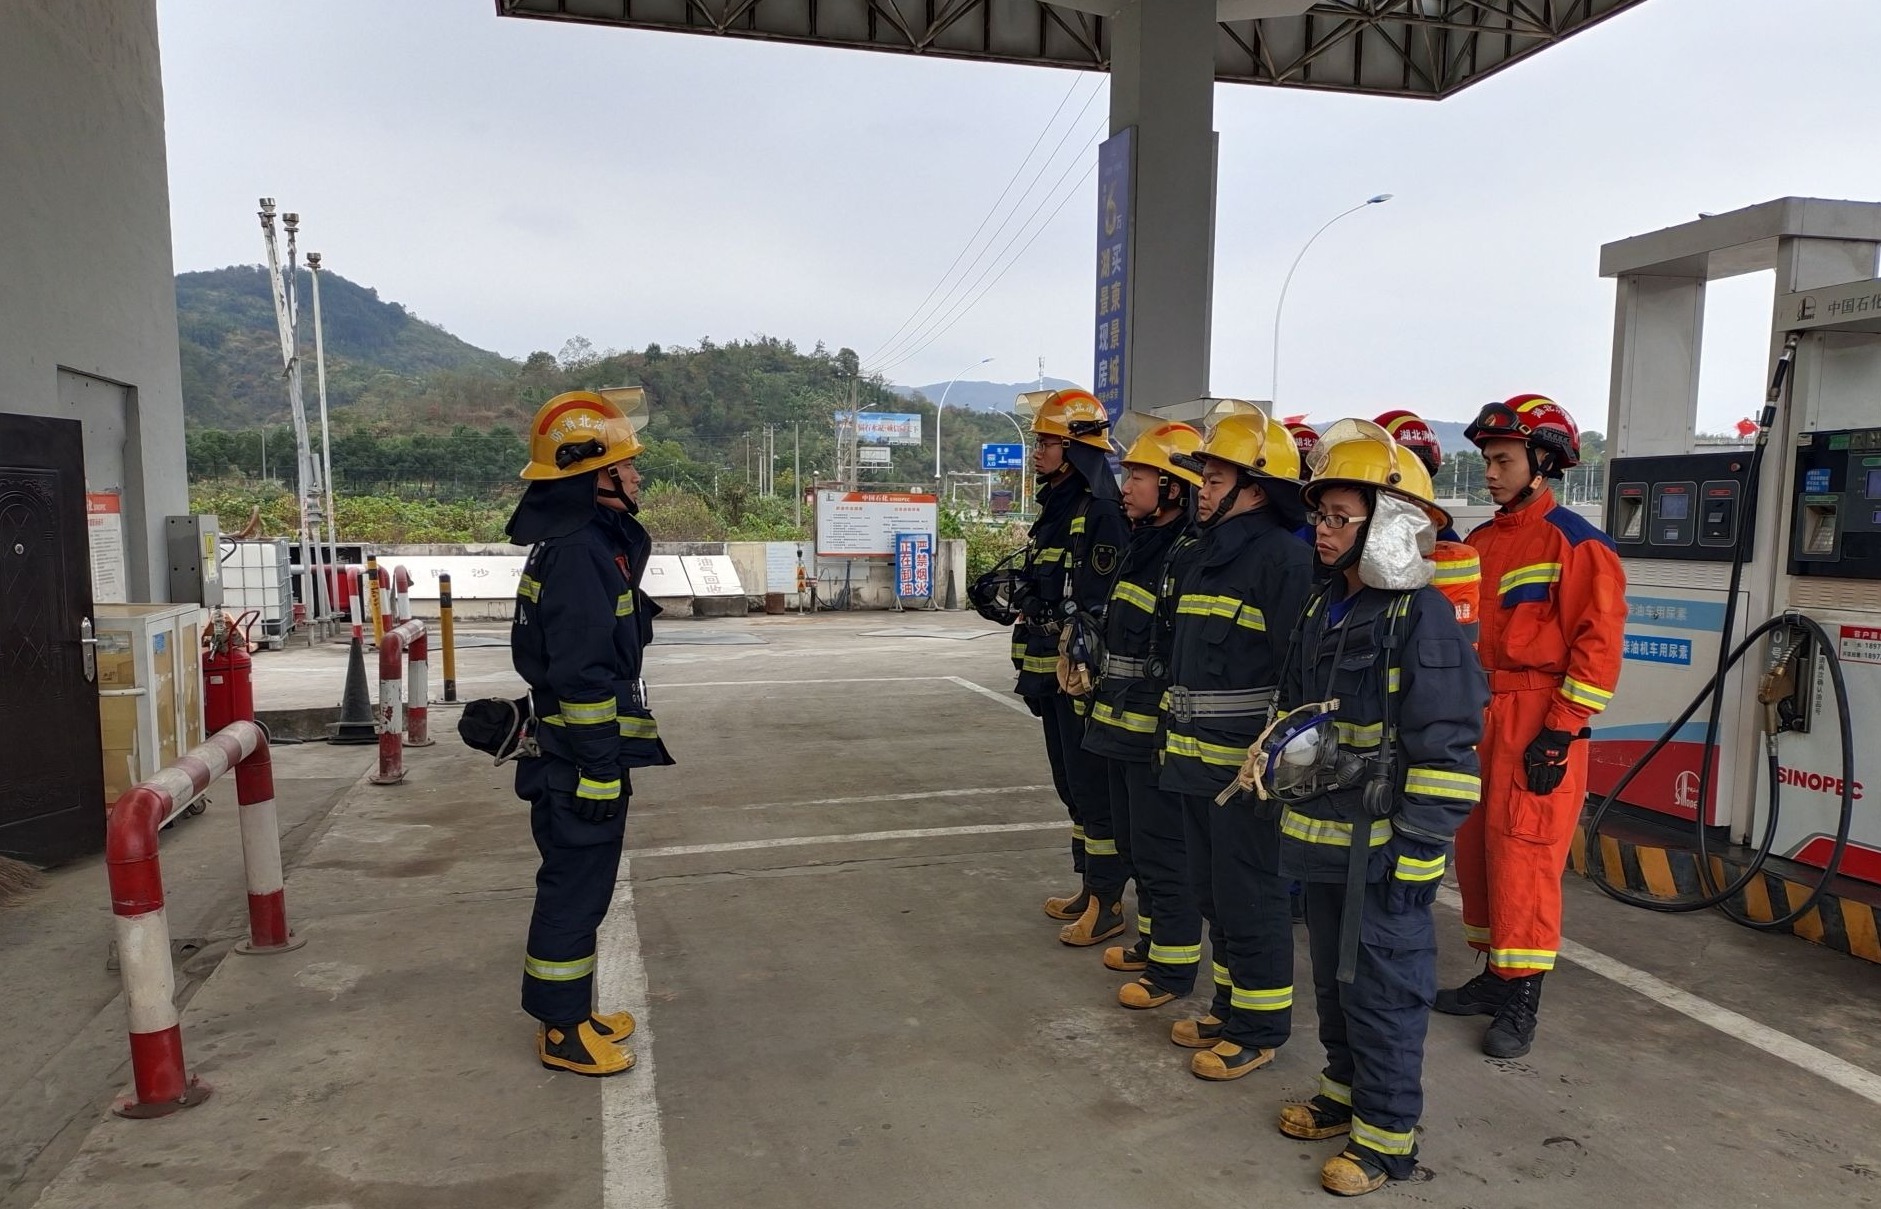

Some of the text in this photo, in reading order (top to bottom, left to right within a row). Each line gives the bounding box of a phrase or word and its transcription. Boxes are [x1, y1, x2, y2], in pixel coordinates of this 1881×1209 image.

[1828, 294, 1881, 316] 中国石化
[861, 494, 889, 502] 中国石化
[694, 557, 721, 595] 油气回收
[900, 540, 914, 596] 正在卸油
[915, 540, 929, 596] 严禁烟火
[1623, 640, 1689, 660] 柴油机车用尿素
[1776, 766, 1863, 800] SINOPEC
